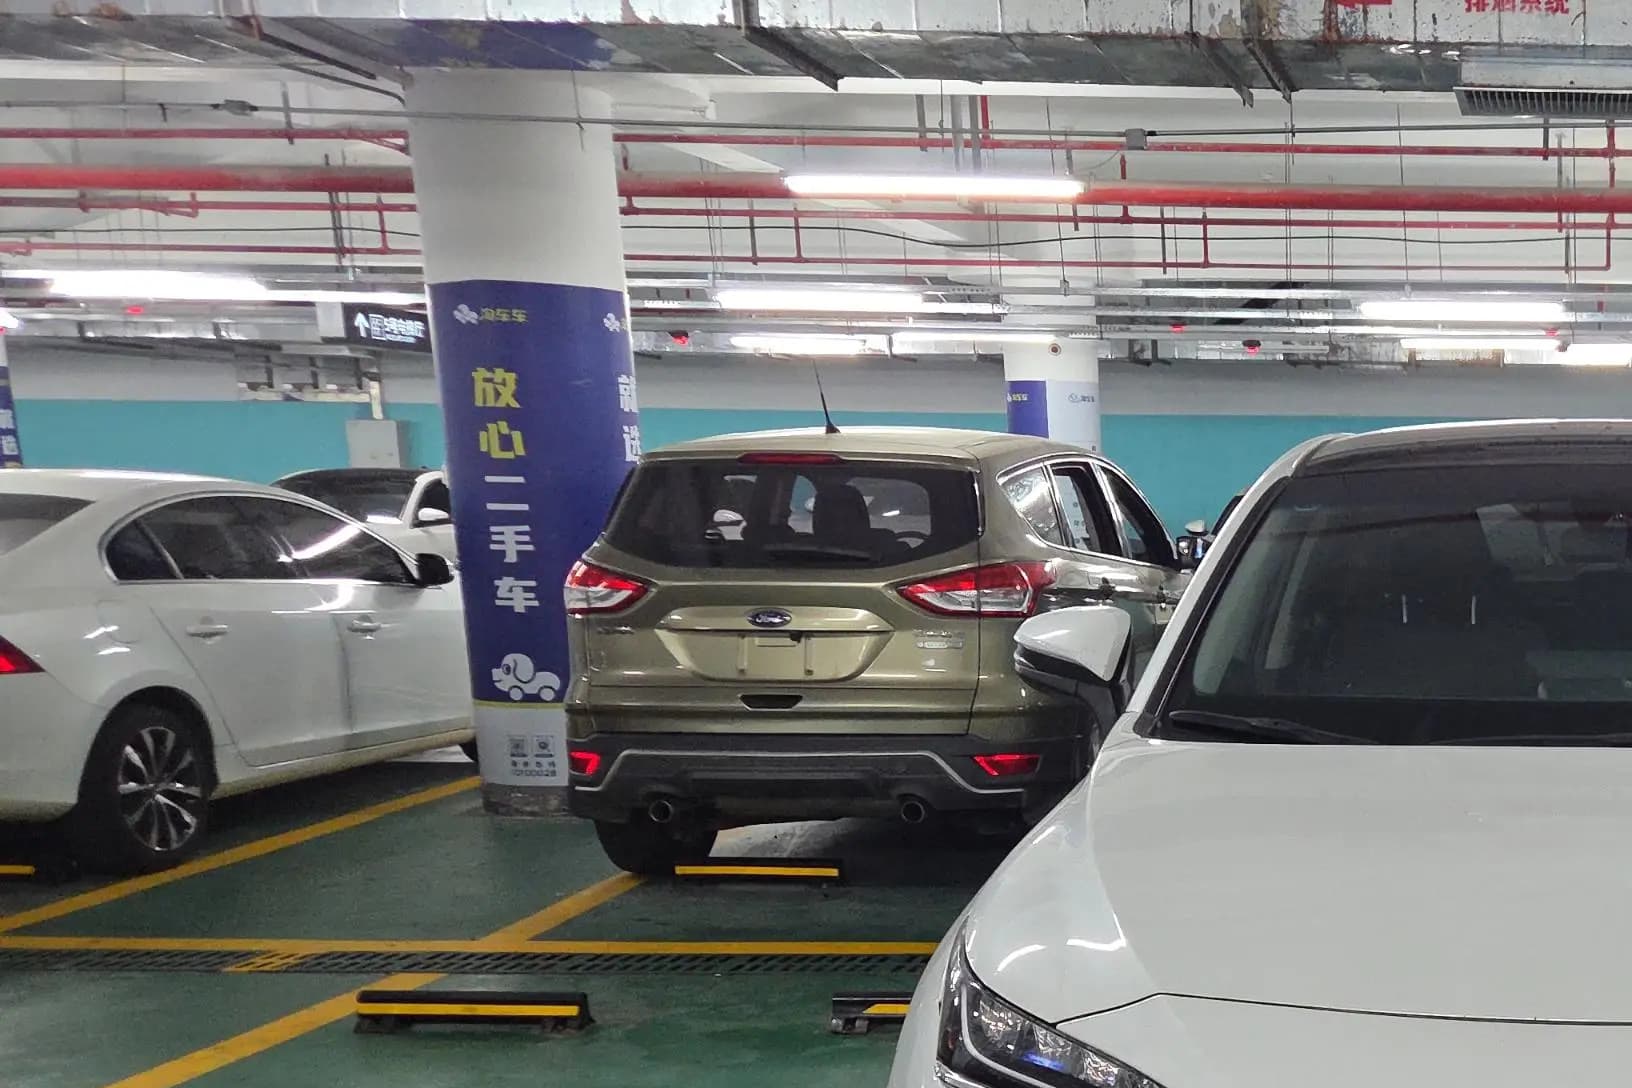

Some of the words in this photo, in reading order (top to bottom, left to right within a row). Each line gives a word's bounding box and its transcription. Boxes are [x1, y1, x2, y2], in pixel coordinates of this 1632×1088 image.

[472, 367, 540, 613] 放心二手车
